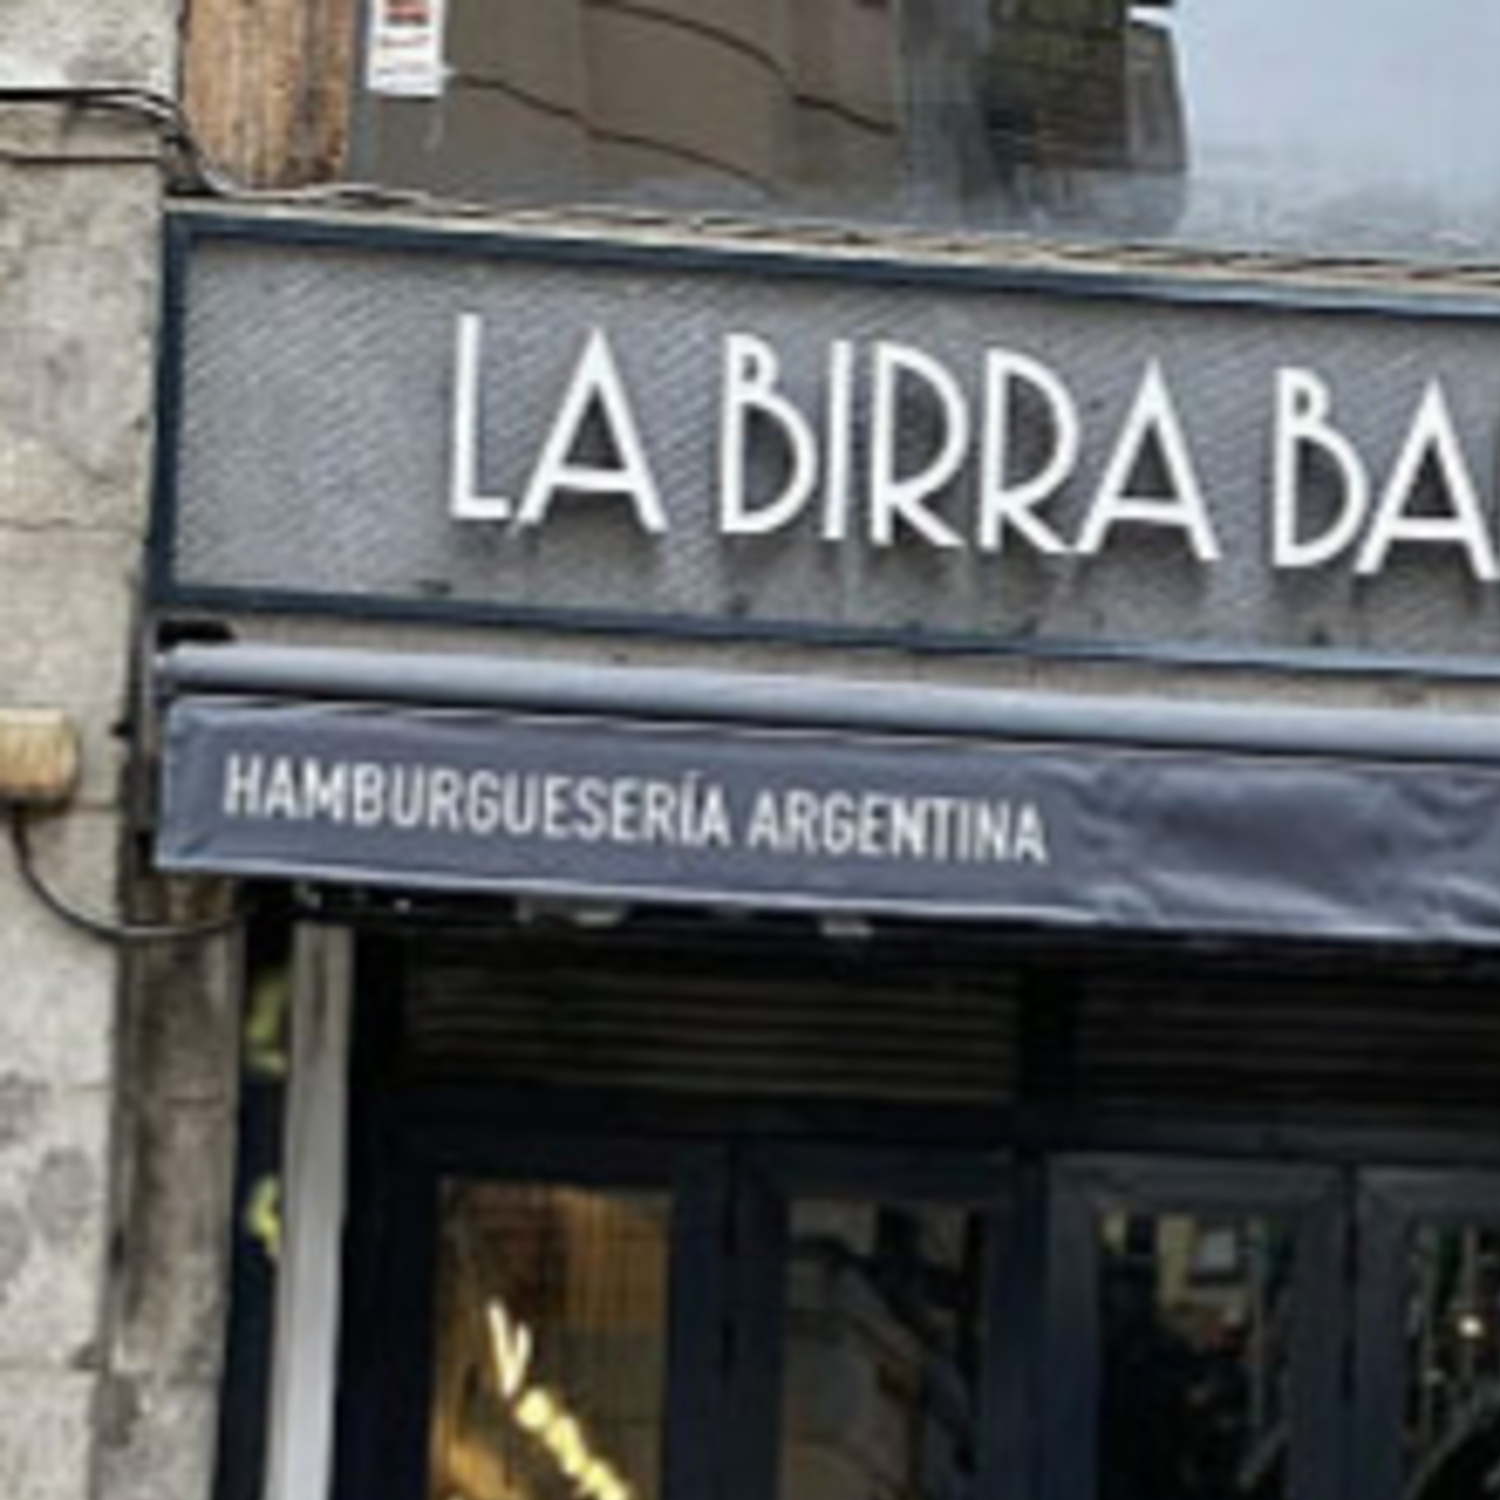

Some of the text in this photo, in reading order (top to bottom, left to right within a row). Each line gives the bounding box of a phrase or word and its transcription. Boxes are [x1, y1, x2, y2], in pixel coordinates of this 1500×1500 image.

[451, 313, 666, 531] LA
[720, 332, 1220, 560] BIRRA
[224, 754, 1048, 863] HAMBURGUESERÍA ARGENTINA
